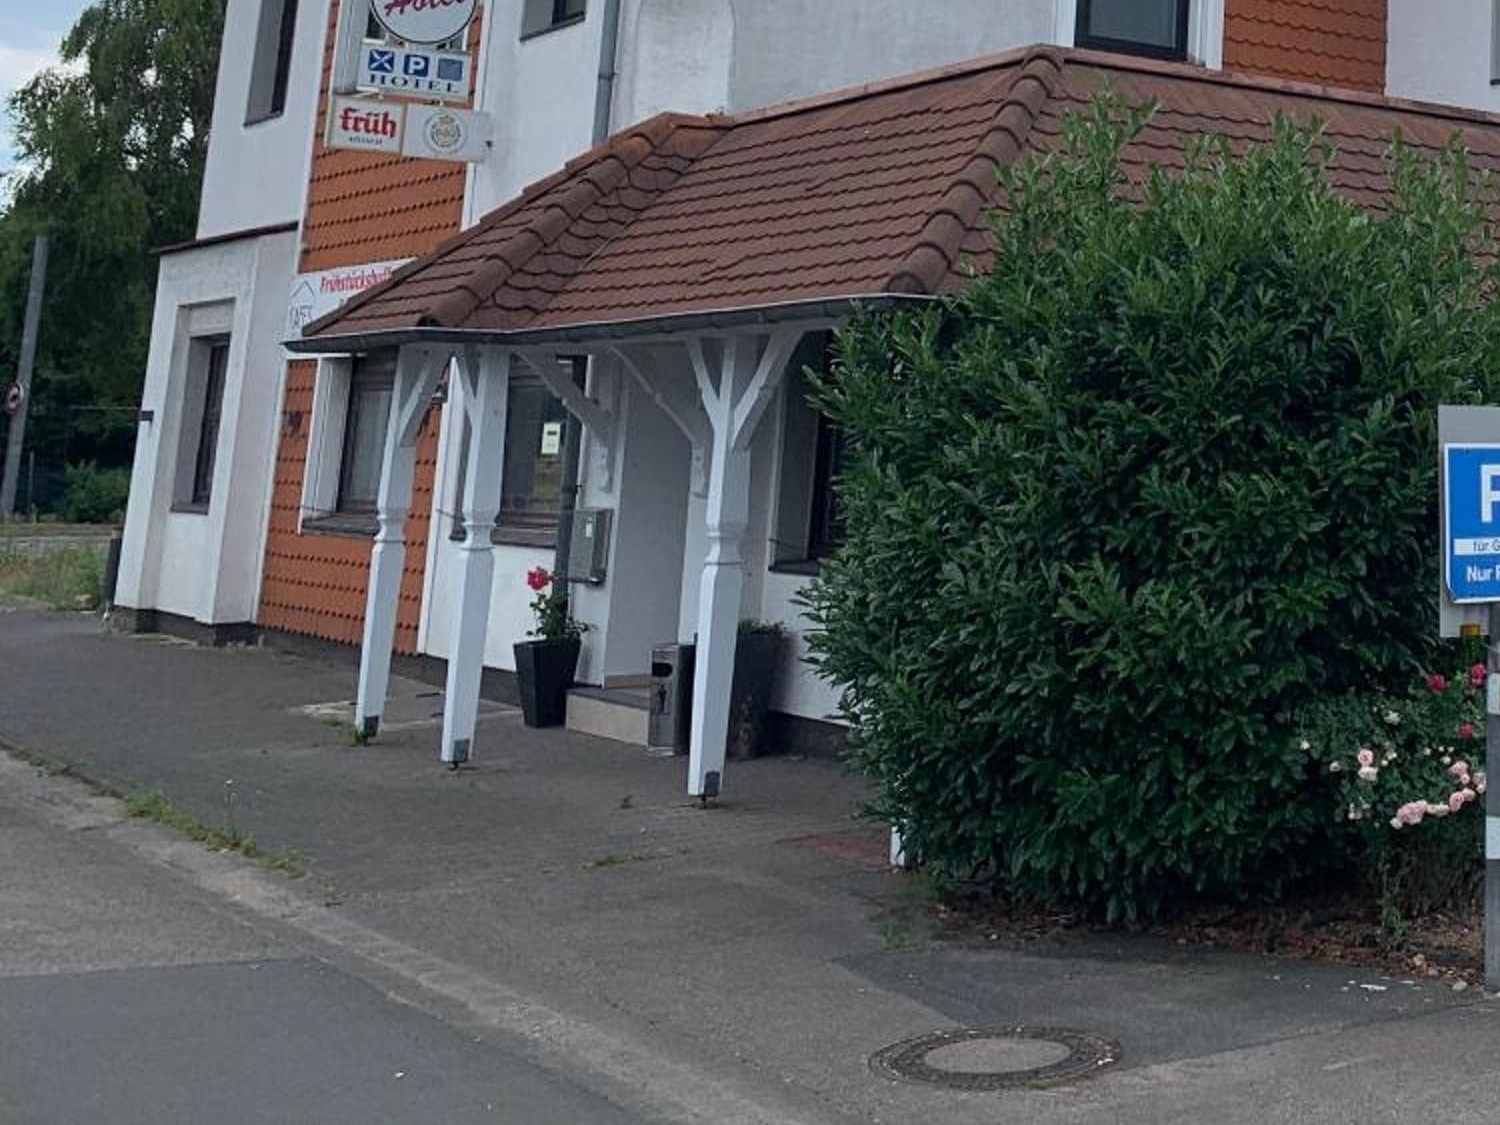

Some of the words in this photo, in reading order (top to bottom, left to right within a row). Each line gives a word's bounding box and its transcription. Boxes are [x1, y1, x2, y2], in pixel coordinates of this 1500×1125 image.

[408, 56, 425, 74] P
[370, 74, 459, 93] HOTEL
[340, 107, 396, 138] früh
[1473, 540, 1490, 552] für
[1466, 565, 1492, 583] Nur
